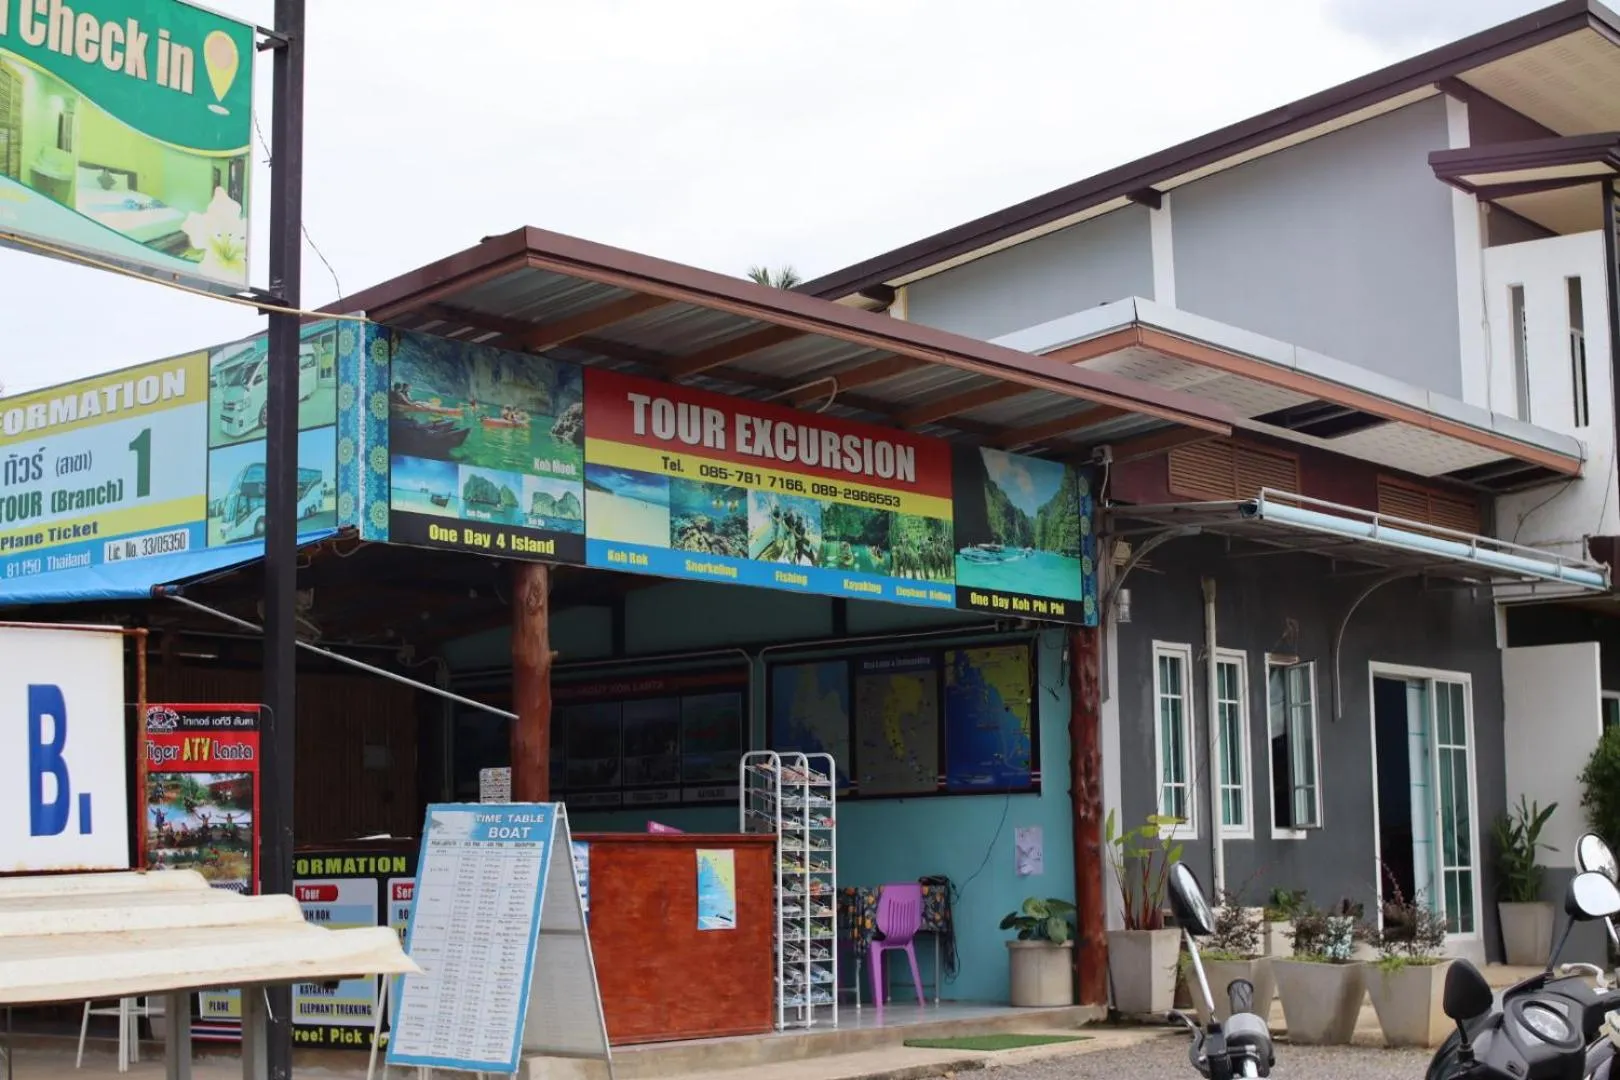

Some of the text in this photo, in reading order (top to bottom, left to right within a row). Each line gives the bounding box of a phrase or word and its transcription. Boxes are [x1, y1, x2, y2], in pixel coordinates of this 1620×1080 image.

[19, 0, 149, 80] Check
[157, 29, 194, 95] in
[0, 368, 186, 435] ORMATION
[628, 393, 916, 483] TOUR EXCURSION
[56, 450, 93, 477] (สาขา)
[129, 428, 151, 498] 1
[661, 456, 901, 508] Tel. 085-781 7166, 089-2966553
[51, 478, 123, 514] (Branch)
[0, 520, 98, 551] Plane Ticket
[142, 531, 186, 556] 33/05350
[428, 523, 555, 555] One Day 4 Island
[47, 549, 91, 572] Thailand
[607, 548, 628, 563] Koh
[685, 559, 738, 580] Snorkeling
[774, 570, 808, 587] Fishing
[843, 578, 882, 595] Kayaking
[970, 591, 1064, 615] One Day Koh Phi Phi
[27, 683, 93, 837] B.
[146, 737, 254, 764] Tiger ATV Lanta
[475, 814, 544, 823] TIME TABLE
[488, 826, 531, 839] BOAT
[292, 857, 406, 875] ORMATION
[300, 887, 320, 900] Tour
[300, 1003, 372, 1016] ELEPHANT TREKKING
[292, 1027, 324, 1042] ree!
[330, 1028, 362, 1043] Pick
